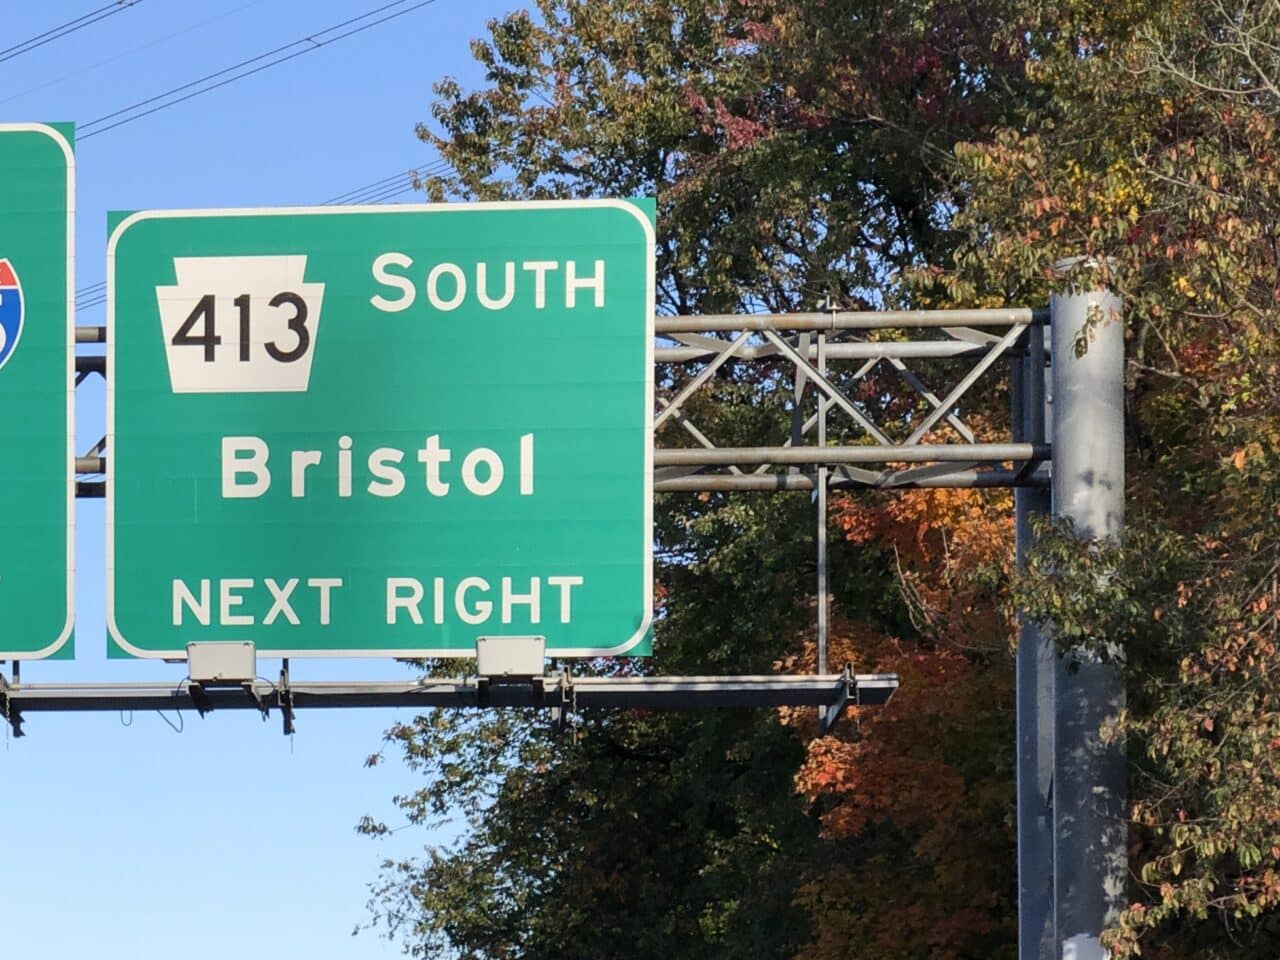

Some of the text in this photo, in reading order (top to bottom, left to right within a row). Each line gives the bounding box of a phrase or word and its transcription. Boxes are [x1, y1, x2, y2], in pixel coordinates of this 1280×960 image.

[370, 252, 605, 312] SOUTH
[171, 292, 310, 363] 413
[221, 433, 534, 498] Bristol
[173, 576, 584, 626] NEXT RIGHT
